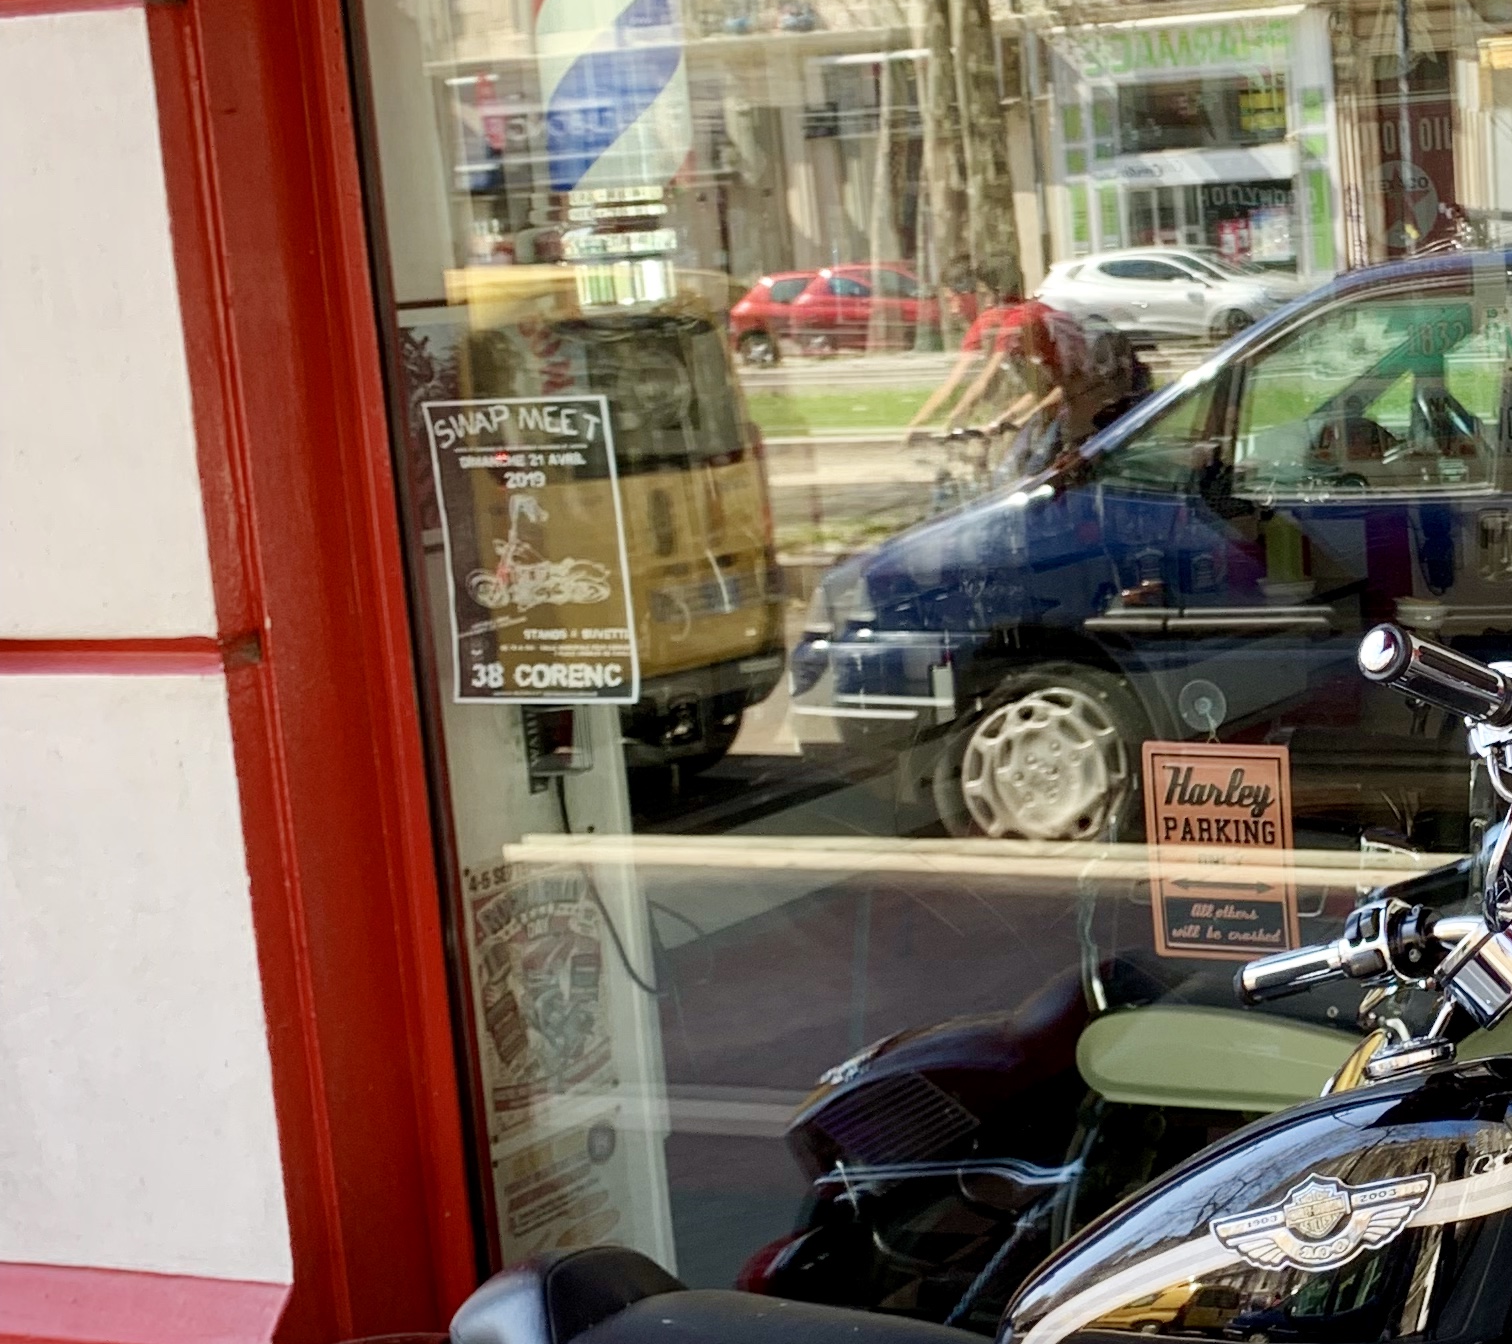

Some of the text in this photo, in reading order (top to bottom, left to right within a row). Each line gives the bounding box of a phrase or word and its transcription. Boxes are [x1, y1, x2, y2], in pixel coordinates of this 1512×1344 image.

[433, 405, 602, 449] SWAP MEET
[504, 471, 546, 489] 2019
[471, 662, 623, 689] 38 CORENC
[1162, 765, 1276, 818] Harley
[1163, 817, 1276, 845] PARKING
[1191, 902, 1215, 919] All
[1171, 924, 1201, 939] will
